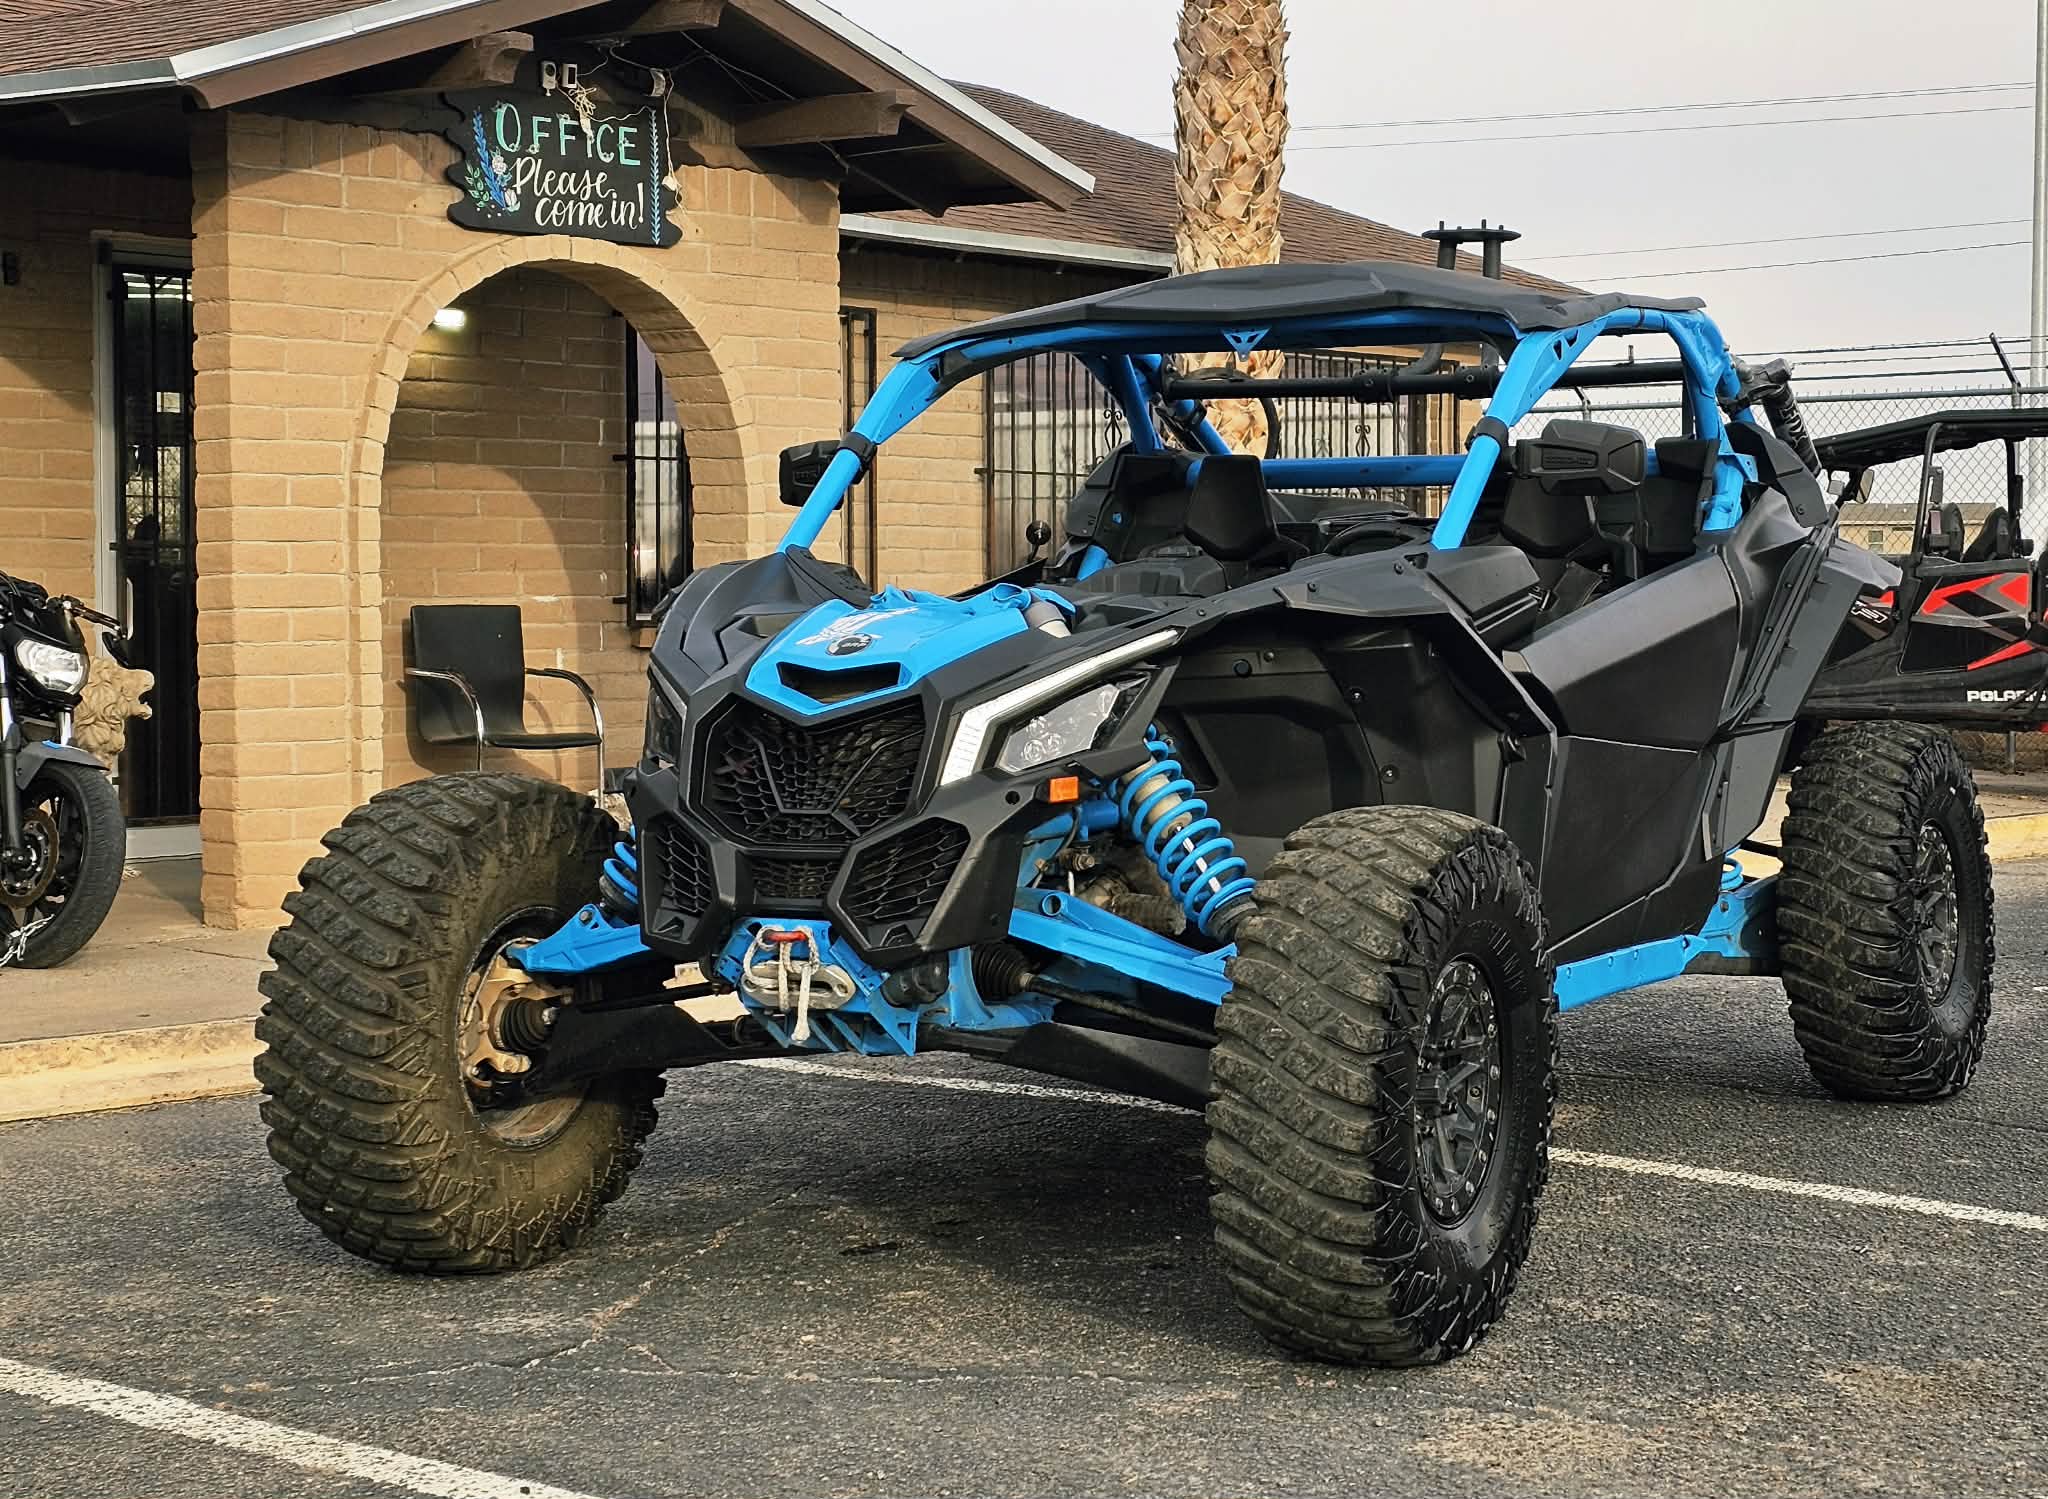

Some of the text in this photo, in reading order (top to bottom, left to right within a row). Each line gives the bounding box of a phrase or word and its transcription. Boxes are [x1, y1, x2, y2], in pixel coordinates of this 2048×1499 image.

[495, 103, 641, 166] OFFICE
[510, 156, 616, 201] Please
[534, 182, 645, 230] come in!
